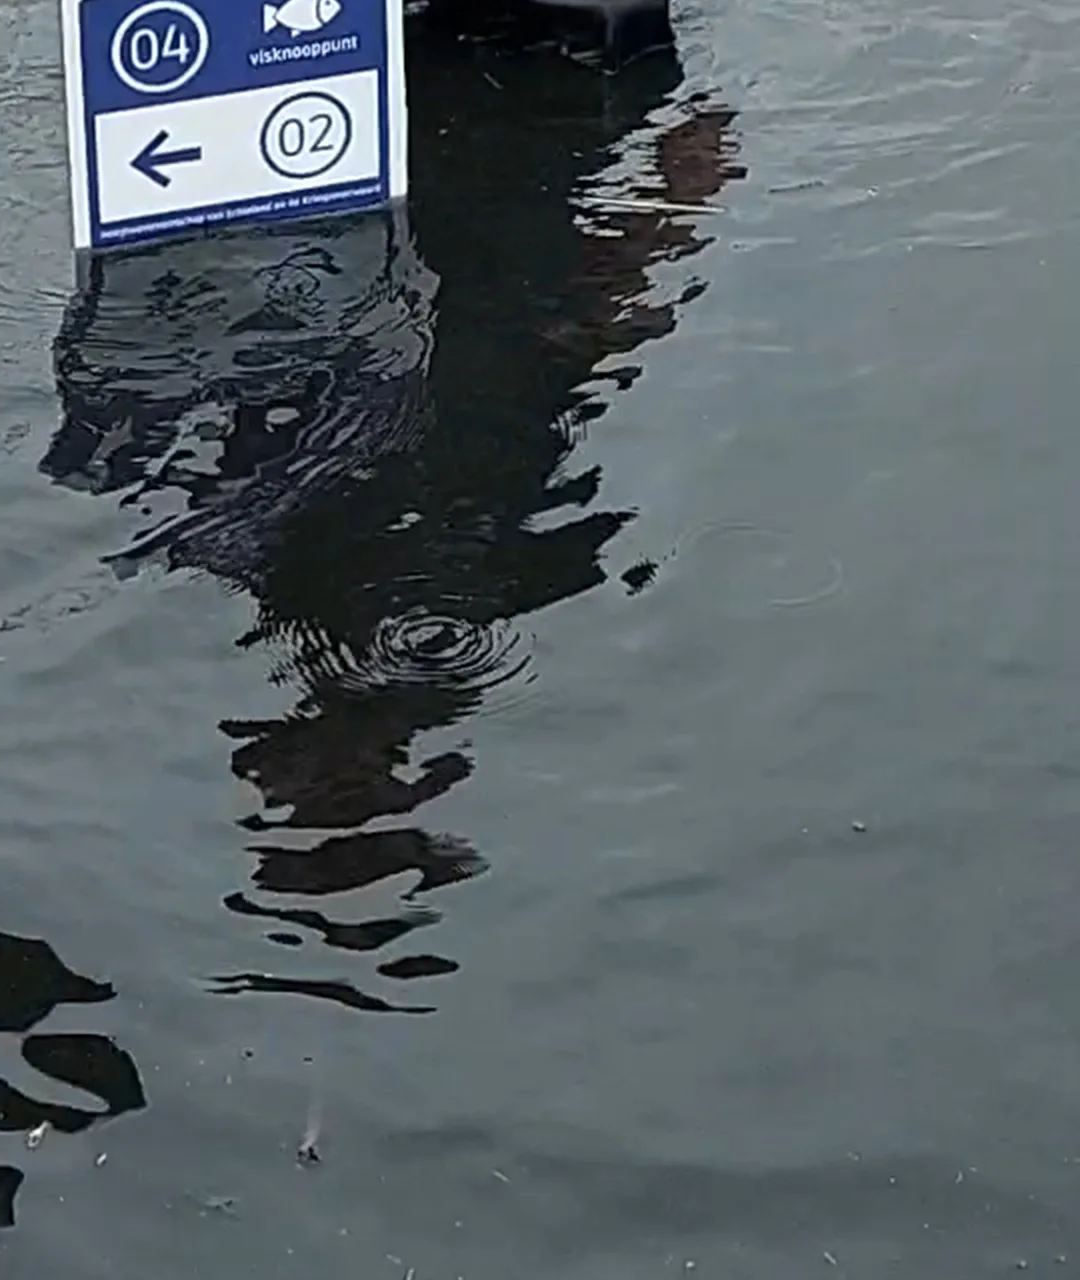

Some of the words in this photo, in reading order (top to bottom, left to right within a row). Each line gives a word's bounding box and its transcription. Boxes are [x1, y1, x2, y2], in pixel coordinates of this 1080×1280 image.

[130, 23, 190, 70] 04
[249, 35, 358, 66] visknooppunt
[278, 113, 334, 157] 02
